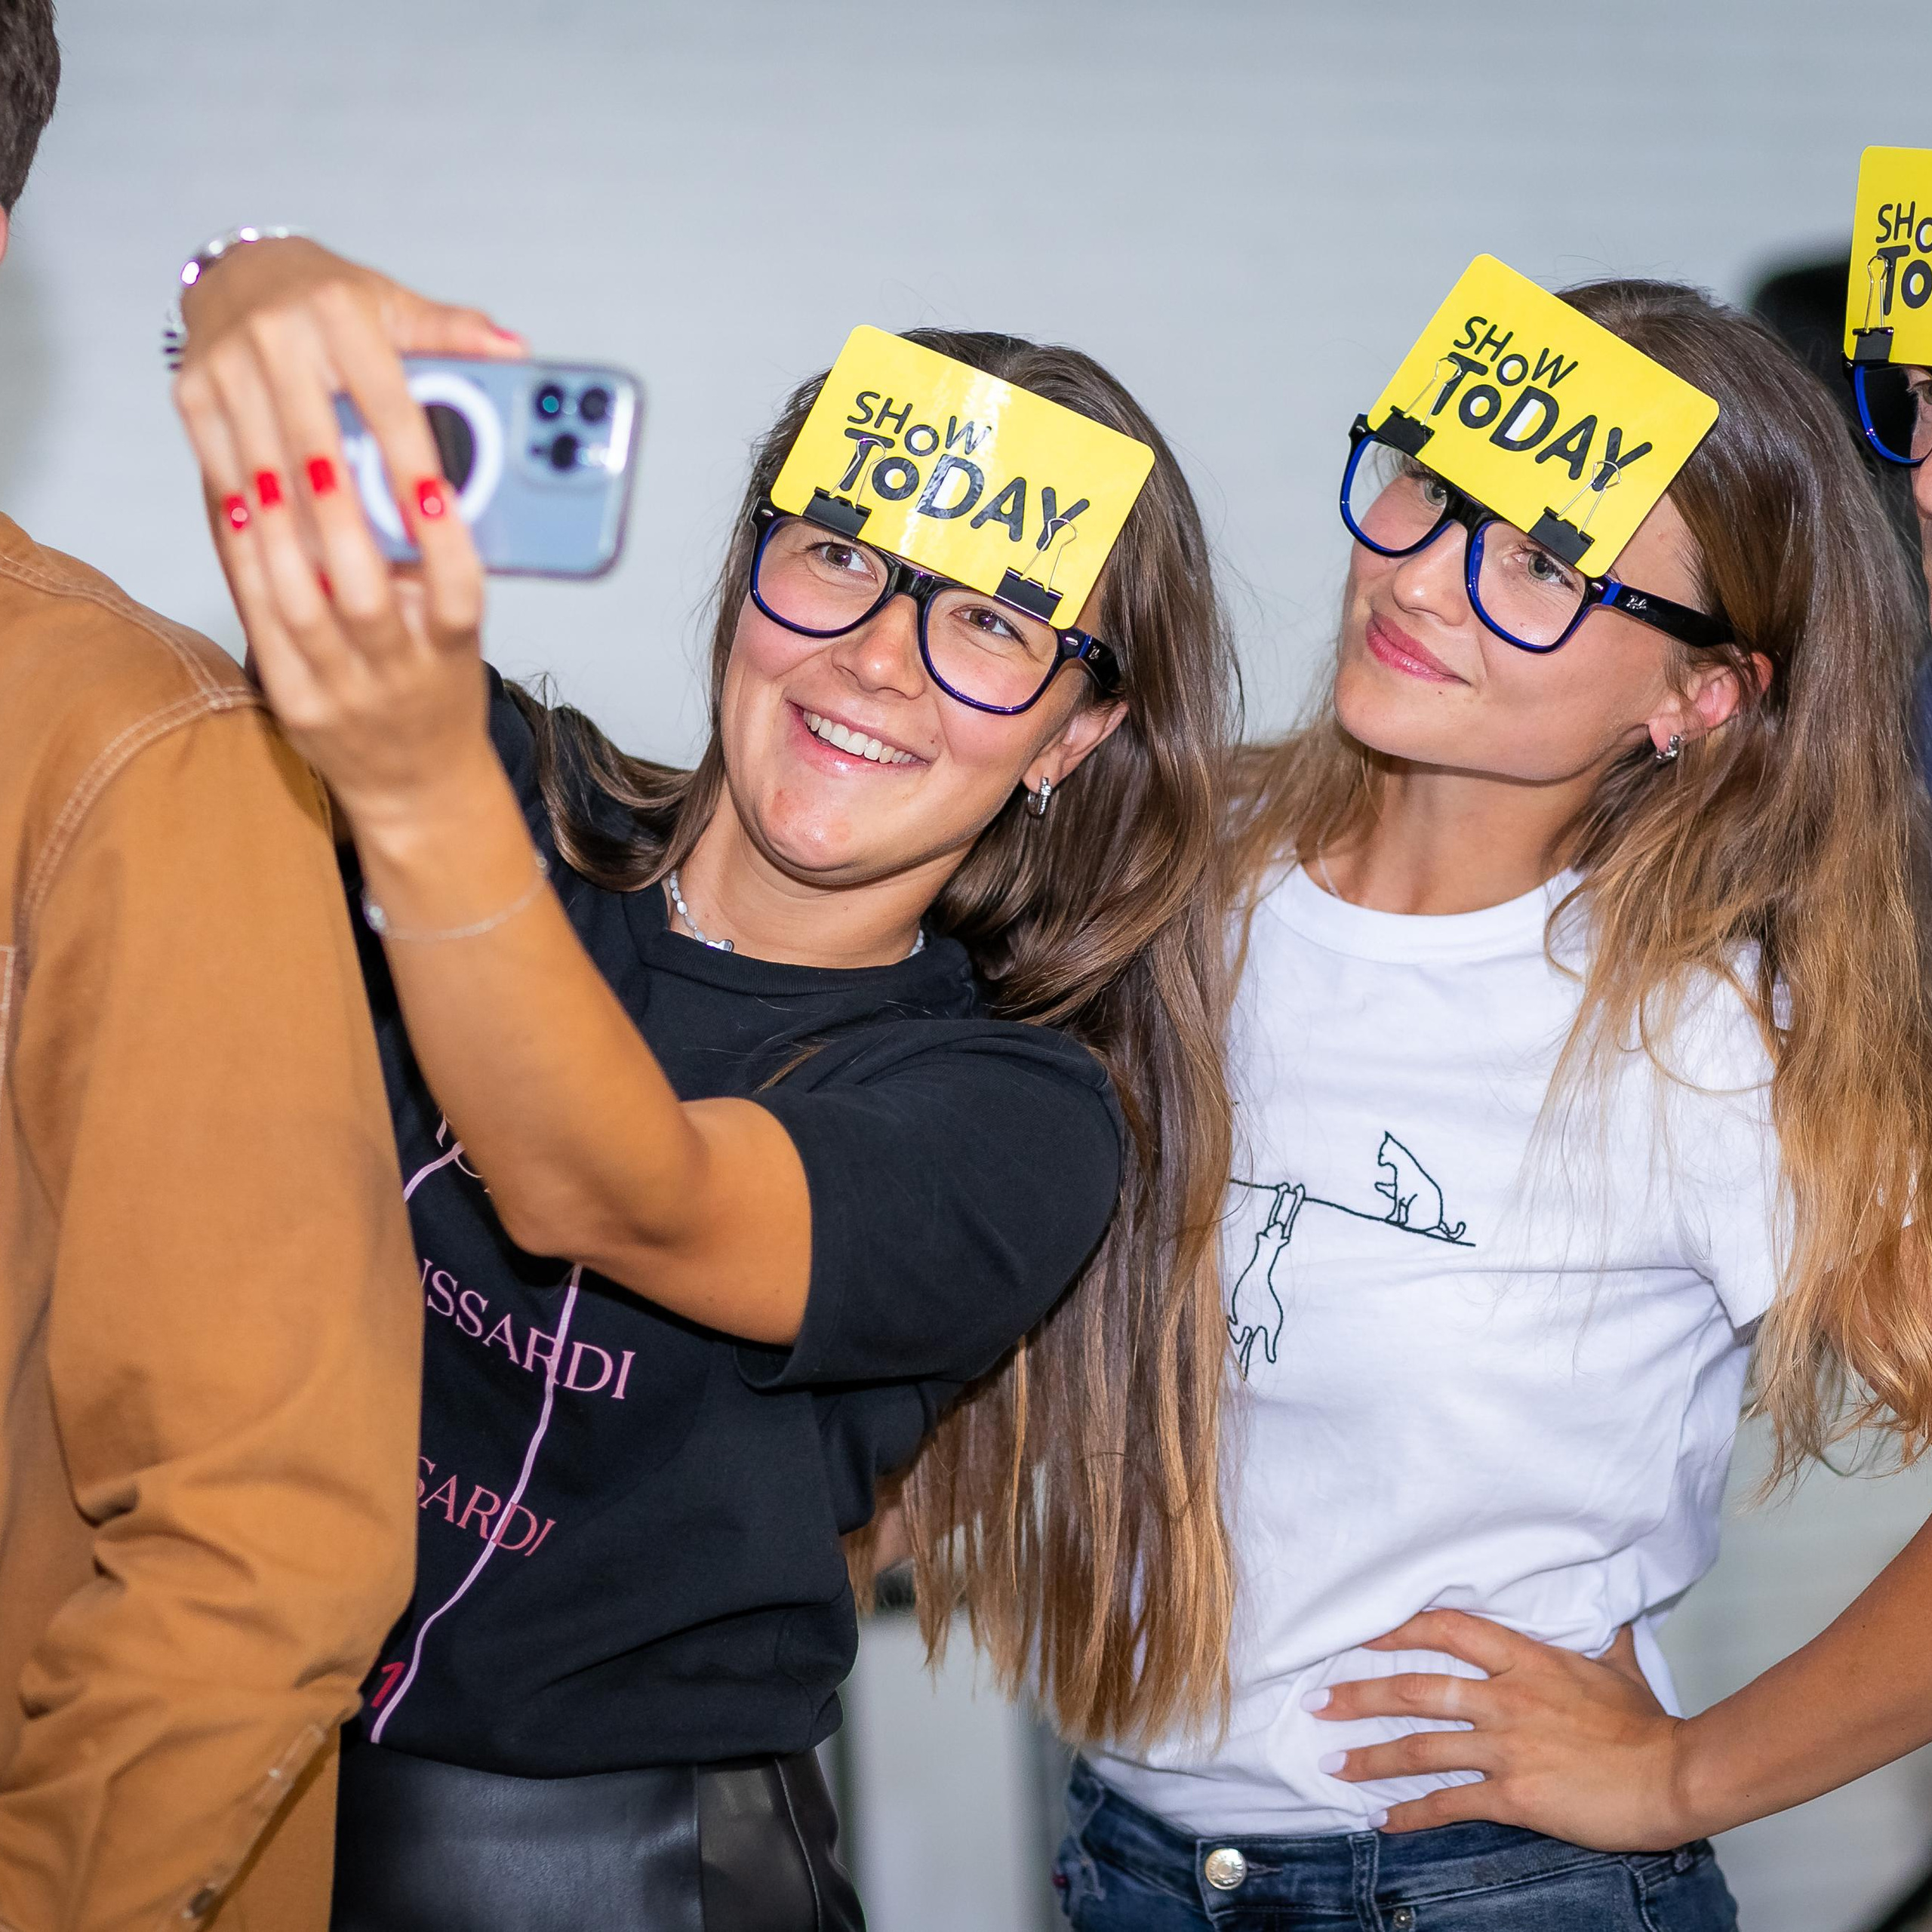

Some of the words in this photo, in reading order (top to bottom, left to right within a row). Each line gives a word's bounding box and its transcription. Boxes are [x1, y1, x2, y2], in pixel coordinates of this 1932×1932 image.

[1453, 315, 1579, 389] SHOW
[846, 390, 992, 457] SHOW
[420, 1258, 636, 1400] SSARDI
